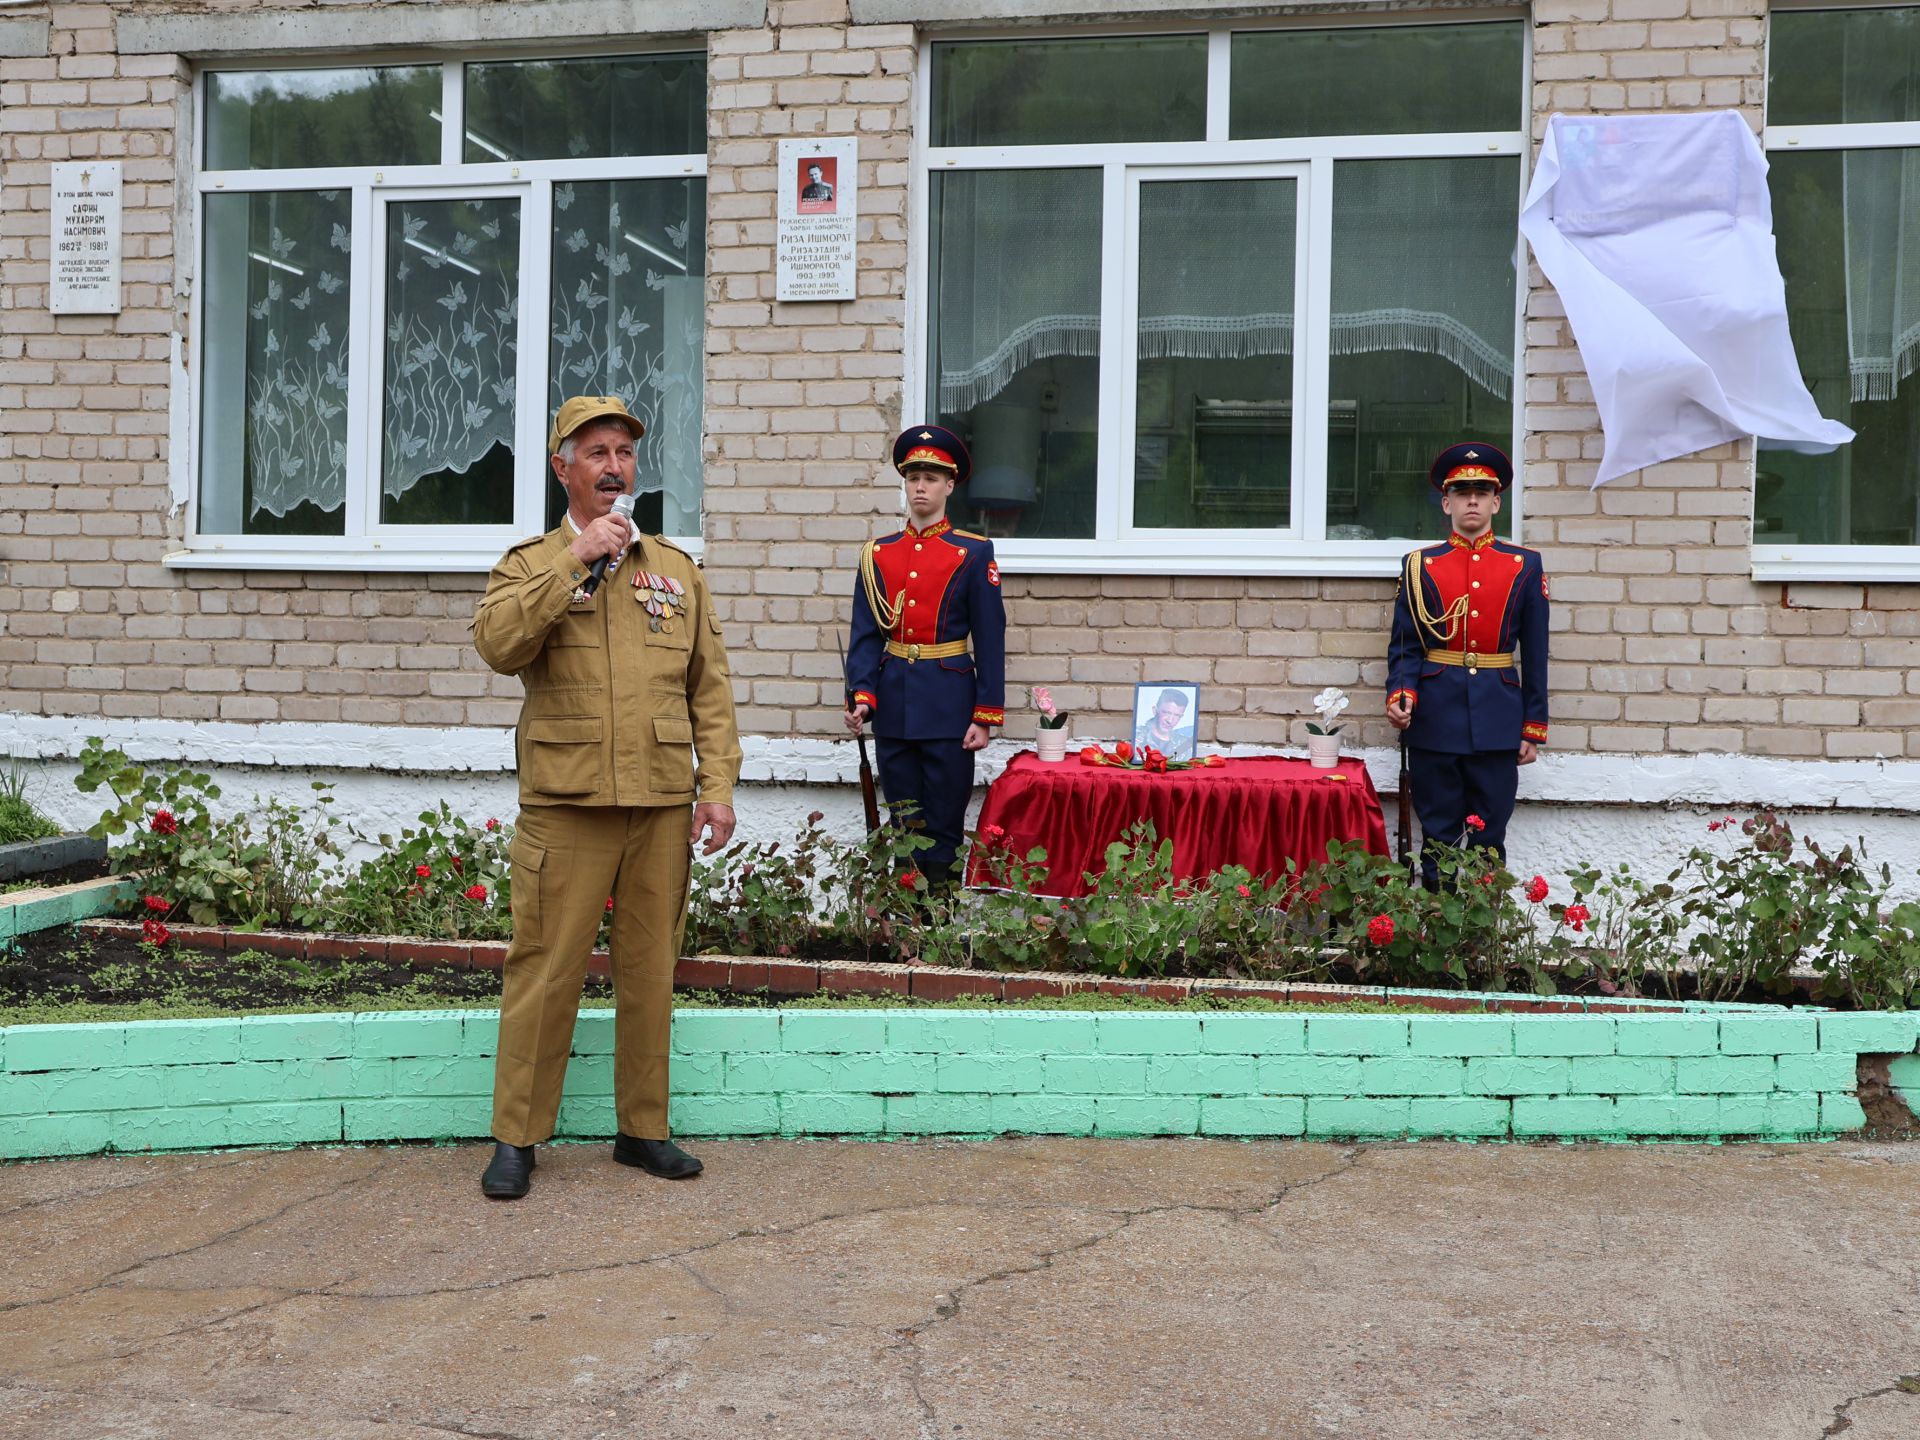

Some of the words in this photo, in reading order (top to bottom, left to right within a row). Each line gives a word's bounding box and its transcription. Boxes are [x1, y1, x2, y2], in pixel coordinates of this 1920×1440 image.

[72, 203, 98, 213] САФИН
[65, 215, 105, 224] МУХАРРЯМ
[63, 226, 106, 236] НАСИМОВИЧ
[807, 233, 851, 243] ИШМОРАТ
[58, 242, 75, 251] 1962
[89, 241, 103, 251] 1981
